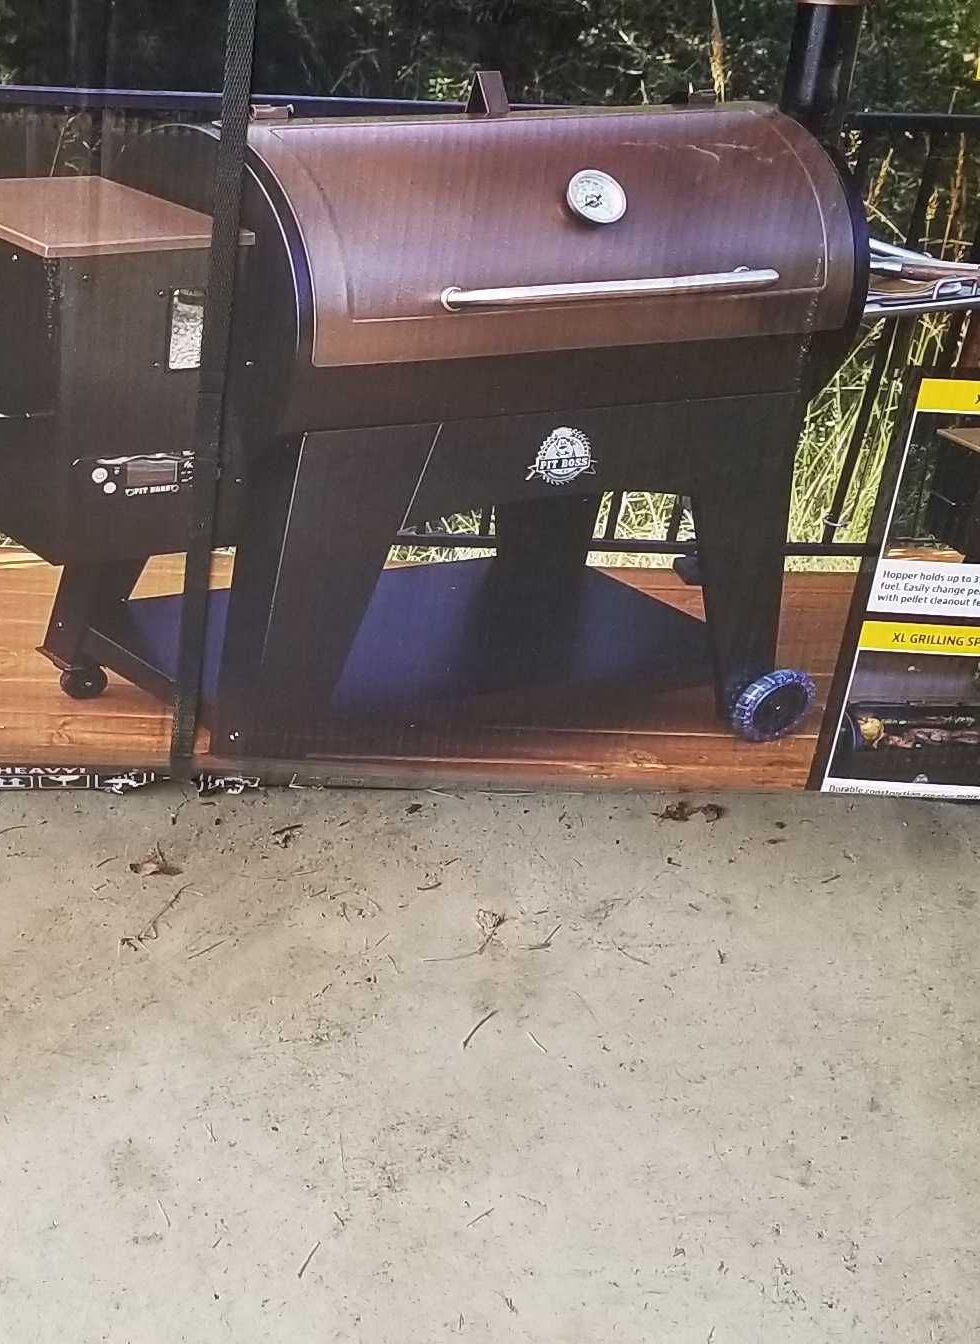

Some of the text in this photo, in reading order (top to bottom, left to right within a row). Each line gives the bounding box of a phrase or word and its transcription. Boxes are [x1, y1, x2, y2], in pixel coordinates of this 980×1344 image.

[539, 457, 589, 470] PIT BOSS
[882, 570, 919, 581] Hopper
[920, 571, 945, 582] holds
[947, 575, 960, 583] up
[961, 574, 972, 583] to
[880, 581, 980, 596] fuel. Easily change pe
[877, 593, 899, 602] with
[899, 596, 928, 605] pellet
[929, 596, 971, 607] cleanout
[892, 632, 907, 643] XL
[909, 633, 965, 646] GRILLING
[828, 784, 863, 793] Durable
